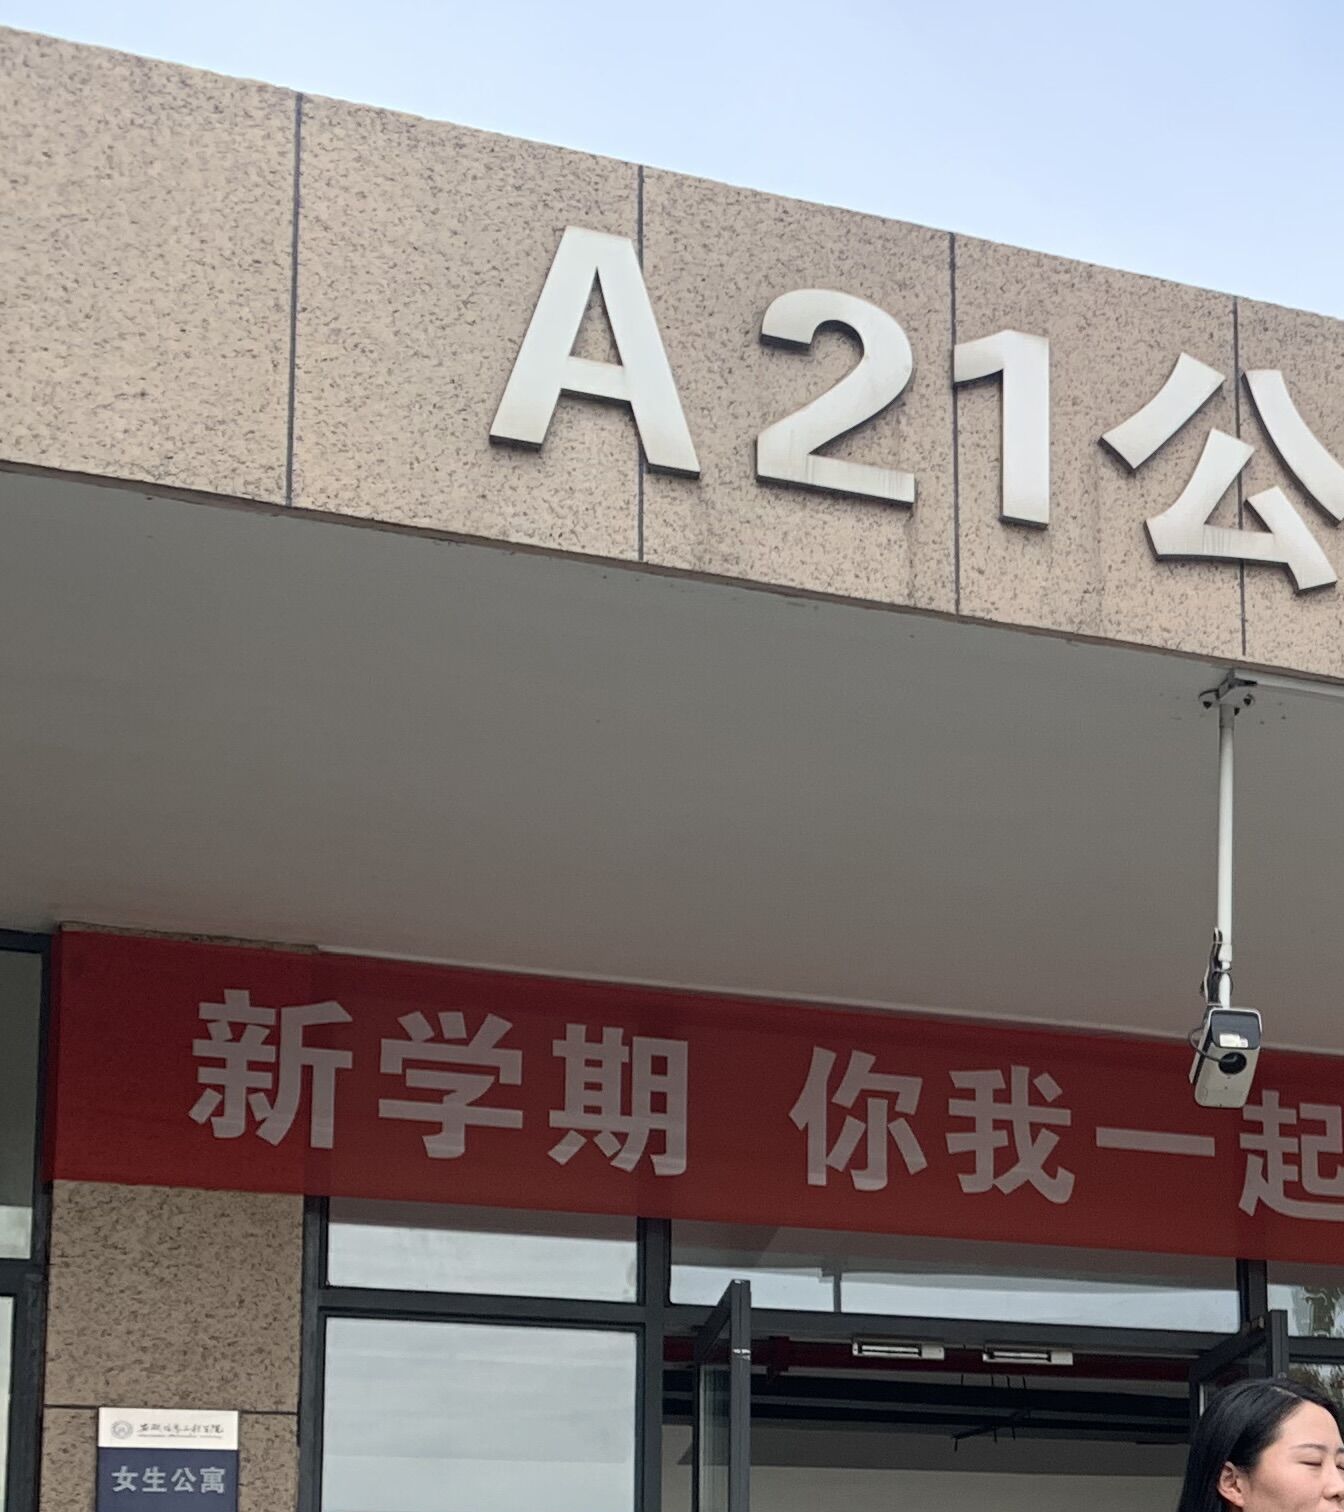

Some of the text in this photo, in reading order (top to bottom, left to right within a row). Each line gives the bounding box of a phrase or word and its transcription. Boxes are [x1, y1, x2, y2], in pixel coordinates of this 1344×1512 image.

[188, 989, 689, 1178] 新学期
[111, 1465, 226, 1494] 女生公寓
